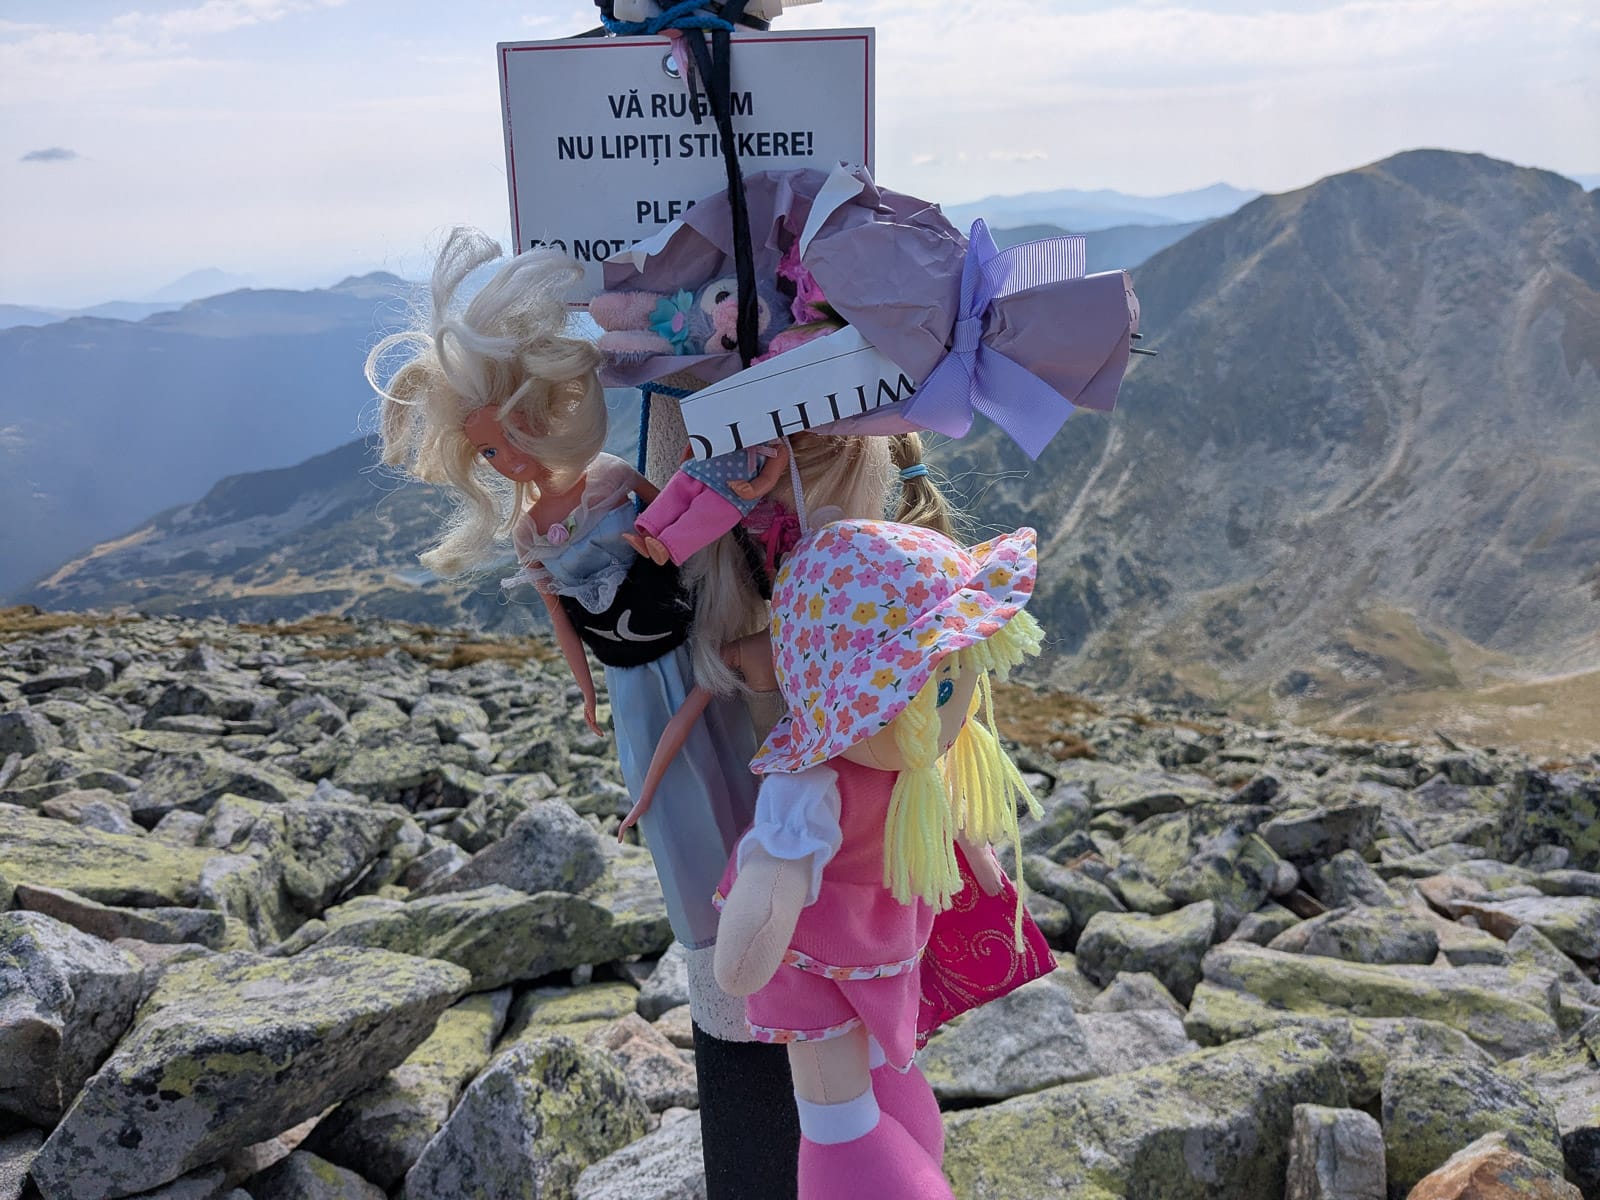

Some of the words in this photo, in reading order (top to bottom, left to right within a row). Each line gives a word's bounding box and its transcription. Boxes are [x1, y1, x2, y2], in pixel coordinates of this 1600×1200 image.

[608, 89, 644, 119] VĂ
[651, 91, 754, 118] RUGM
[557, 136, 594, 160] NU
